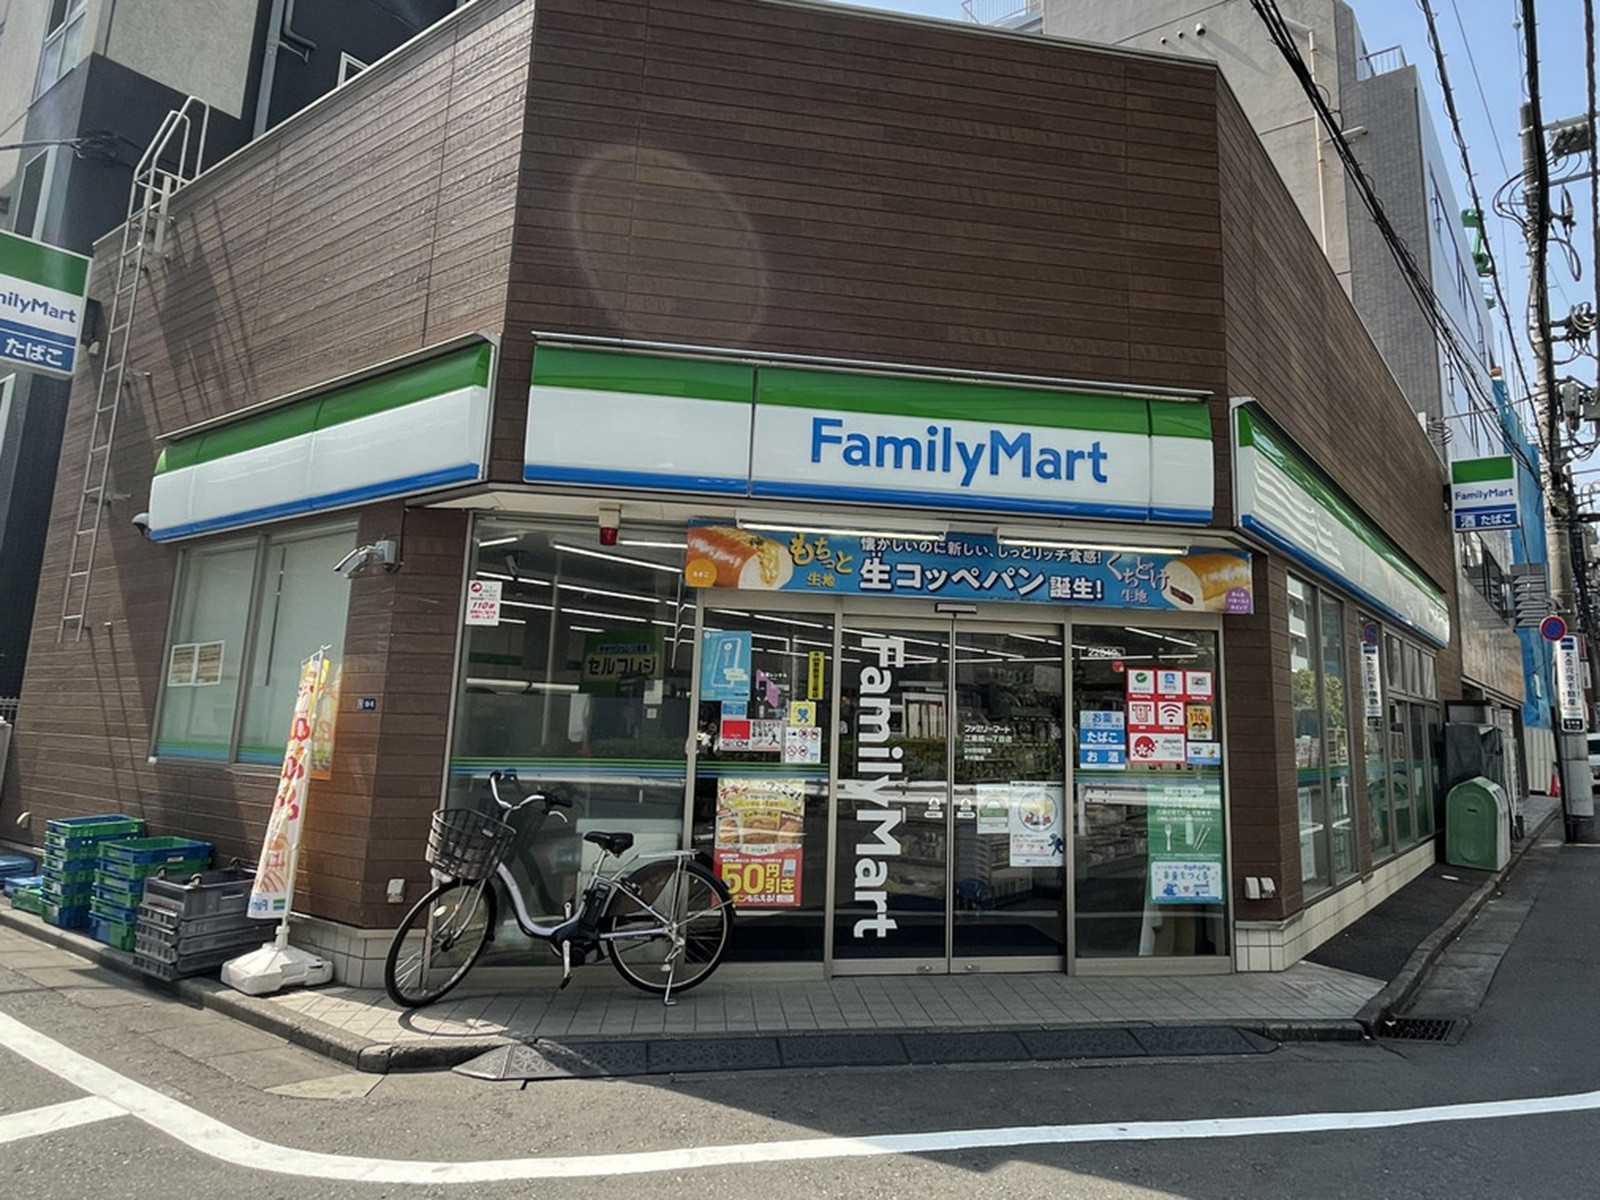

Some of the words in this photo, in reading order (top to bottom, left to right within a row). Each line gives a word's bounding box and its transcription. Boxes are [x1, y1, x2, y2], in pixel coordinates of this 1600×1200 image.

[4, 337, 63, 366] たばこ
[810, 416, 1108, 487] FamilyMart
[1454, 487, 1514, 501] FamilyMart
[1460, 515, 1476, 528] 酒
[1481, 513, 1512, 526] たばこ
[790, 532, 853, 574] もちっと
[807, 572, 837, 587] 生地
[859, 556, 1045, 595] 生コッペパン
[1049, 576, 1103, 600] 誕生!
[1106, 553, 1170, 590] くちどけ
[1121, 588, 1149, 603] 生地
[588, 656, 657, 675] セルフレジ
[963, 724, 1011, 734] ファミリーマート
[1086, 731, 1119, 743] たばこ
[853, 637, 905, 938] FamilyMart
[721, 863, 765, 894] 50
[766, 864, 780, 878] 円
[765, 878, 795, 893] 引き
